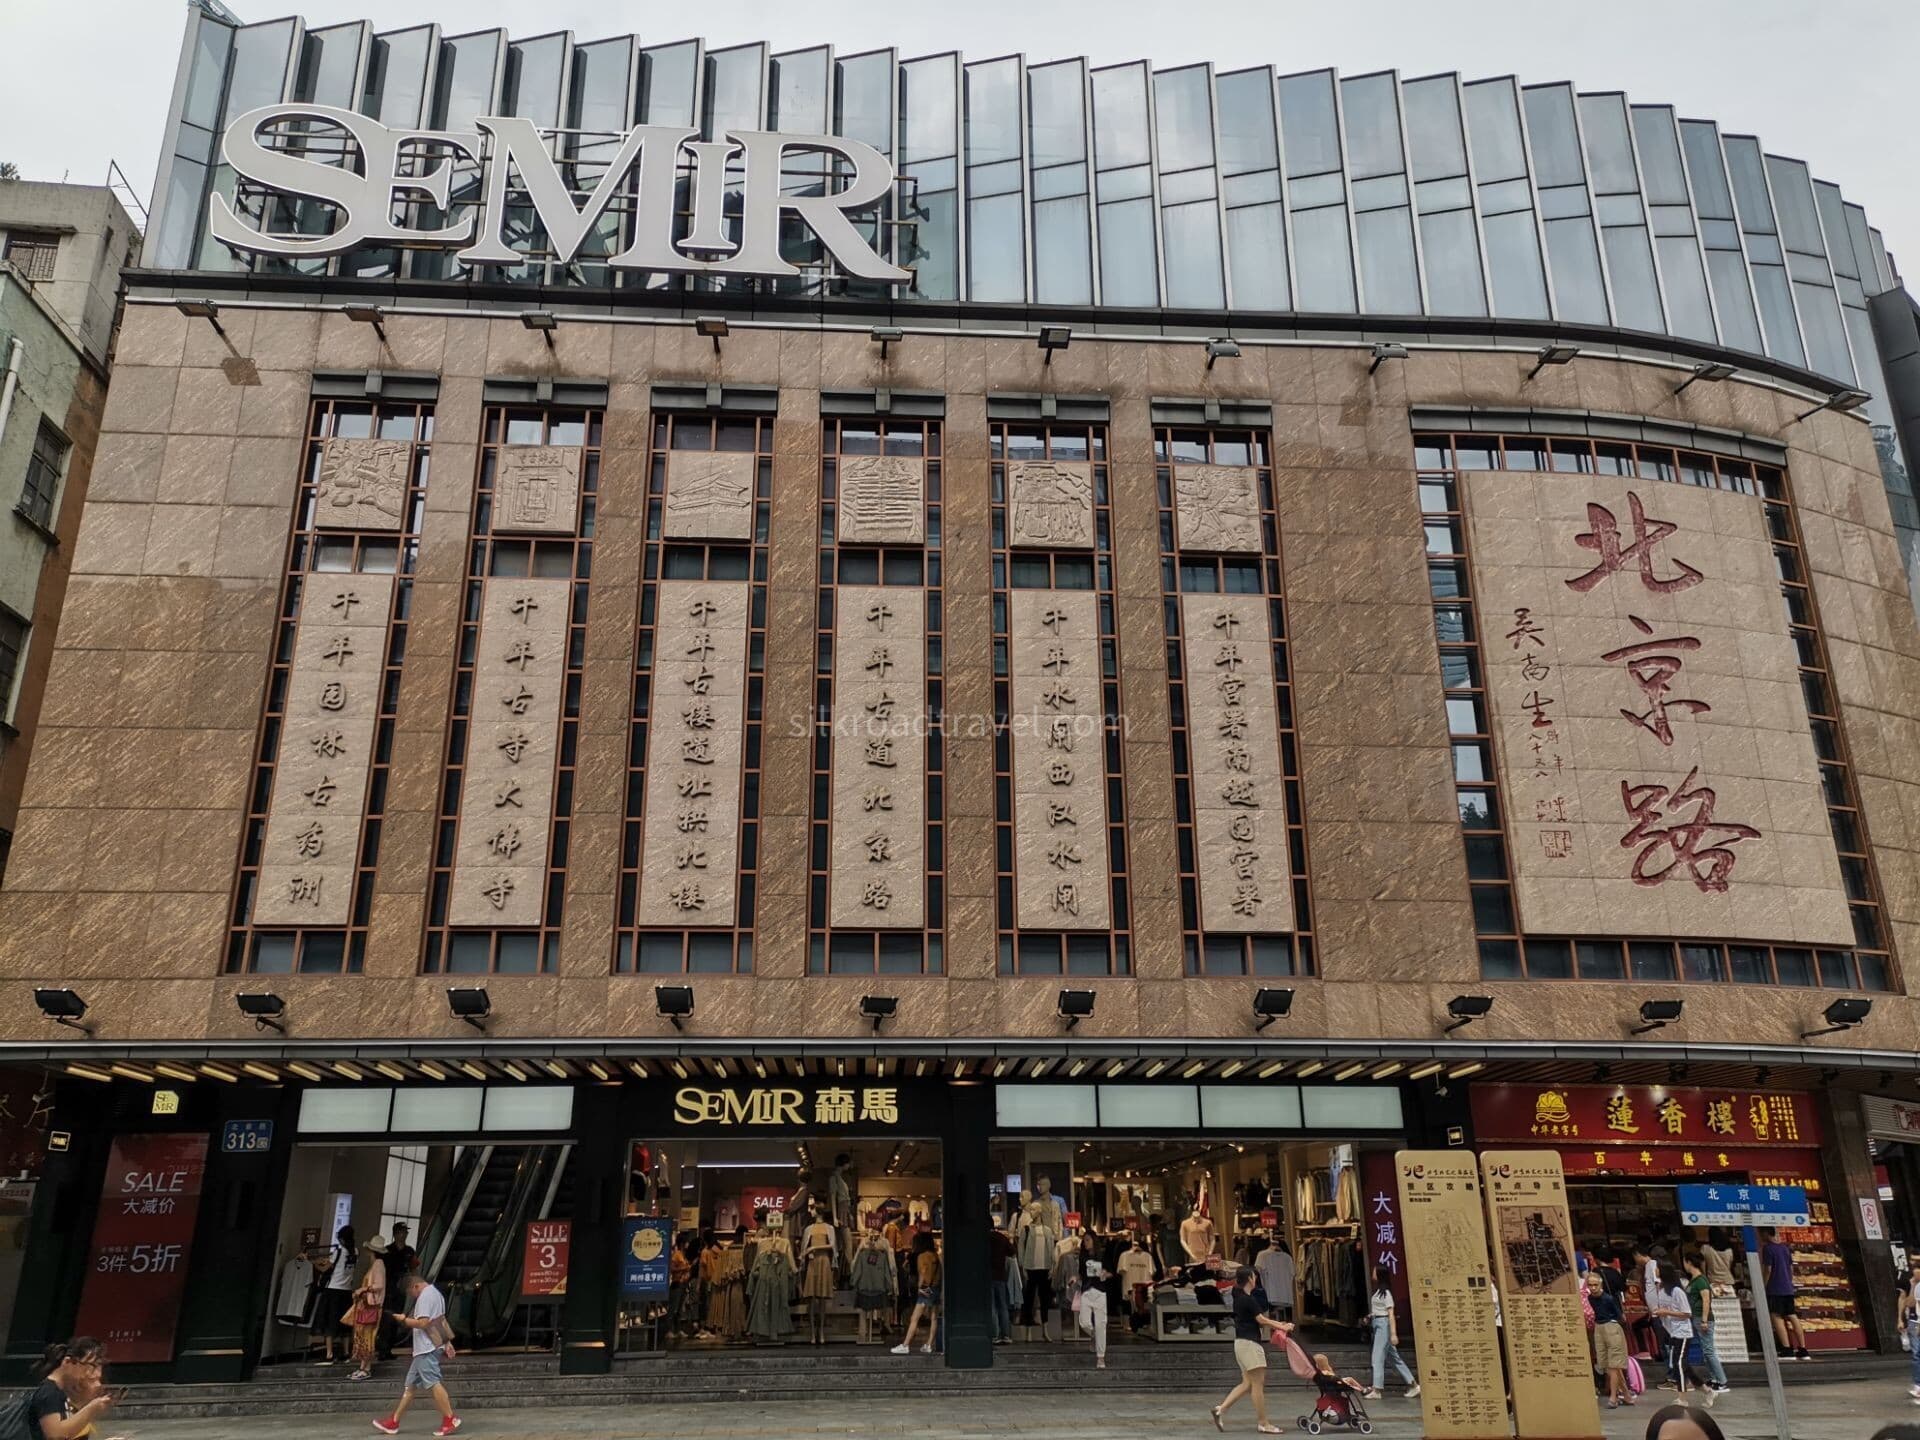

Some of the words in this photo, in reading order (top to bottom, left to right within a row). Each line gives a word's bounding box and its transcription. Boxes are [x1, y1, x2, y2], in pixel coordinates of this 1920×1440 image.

[210, 102, 911, 284] SEMIR
[1564, 490, 1762, 893] 北京路
[674, 1087, 806, 1124] SEMIR
[815, 1086, 898, 1124] 森馬
[1606, 1095, 1737, 1136] 蓮香樓
[227, 1132, 257, 1149] 313
[121, 1171, 188, 1193] SALE
[753, 1196, 784, 1208] SALE
[1707, 1188, 1781, 1201] 北京路
[123, 1198, 175, 1216] 大减价
[1755, 1203, 1765, 1211] LU
[1372, 1191, 1398, 1275] 大减价
[540, 1244, 556, 1268] 3
